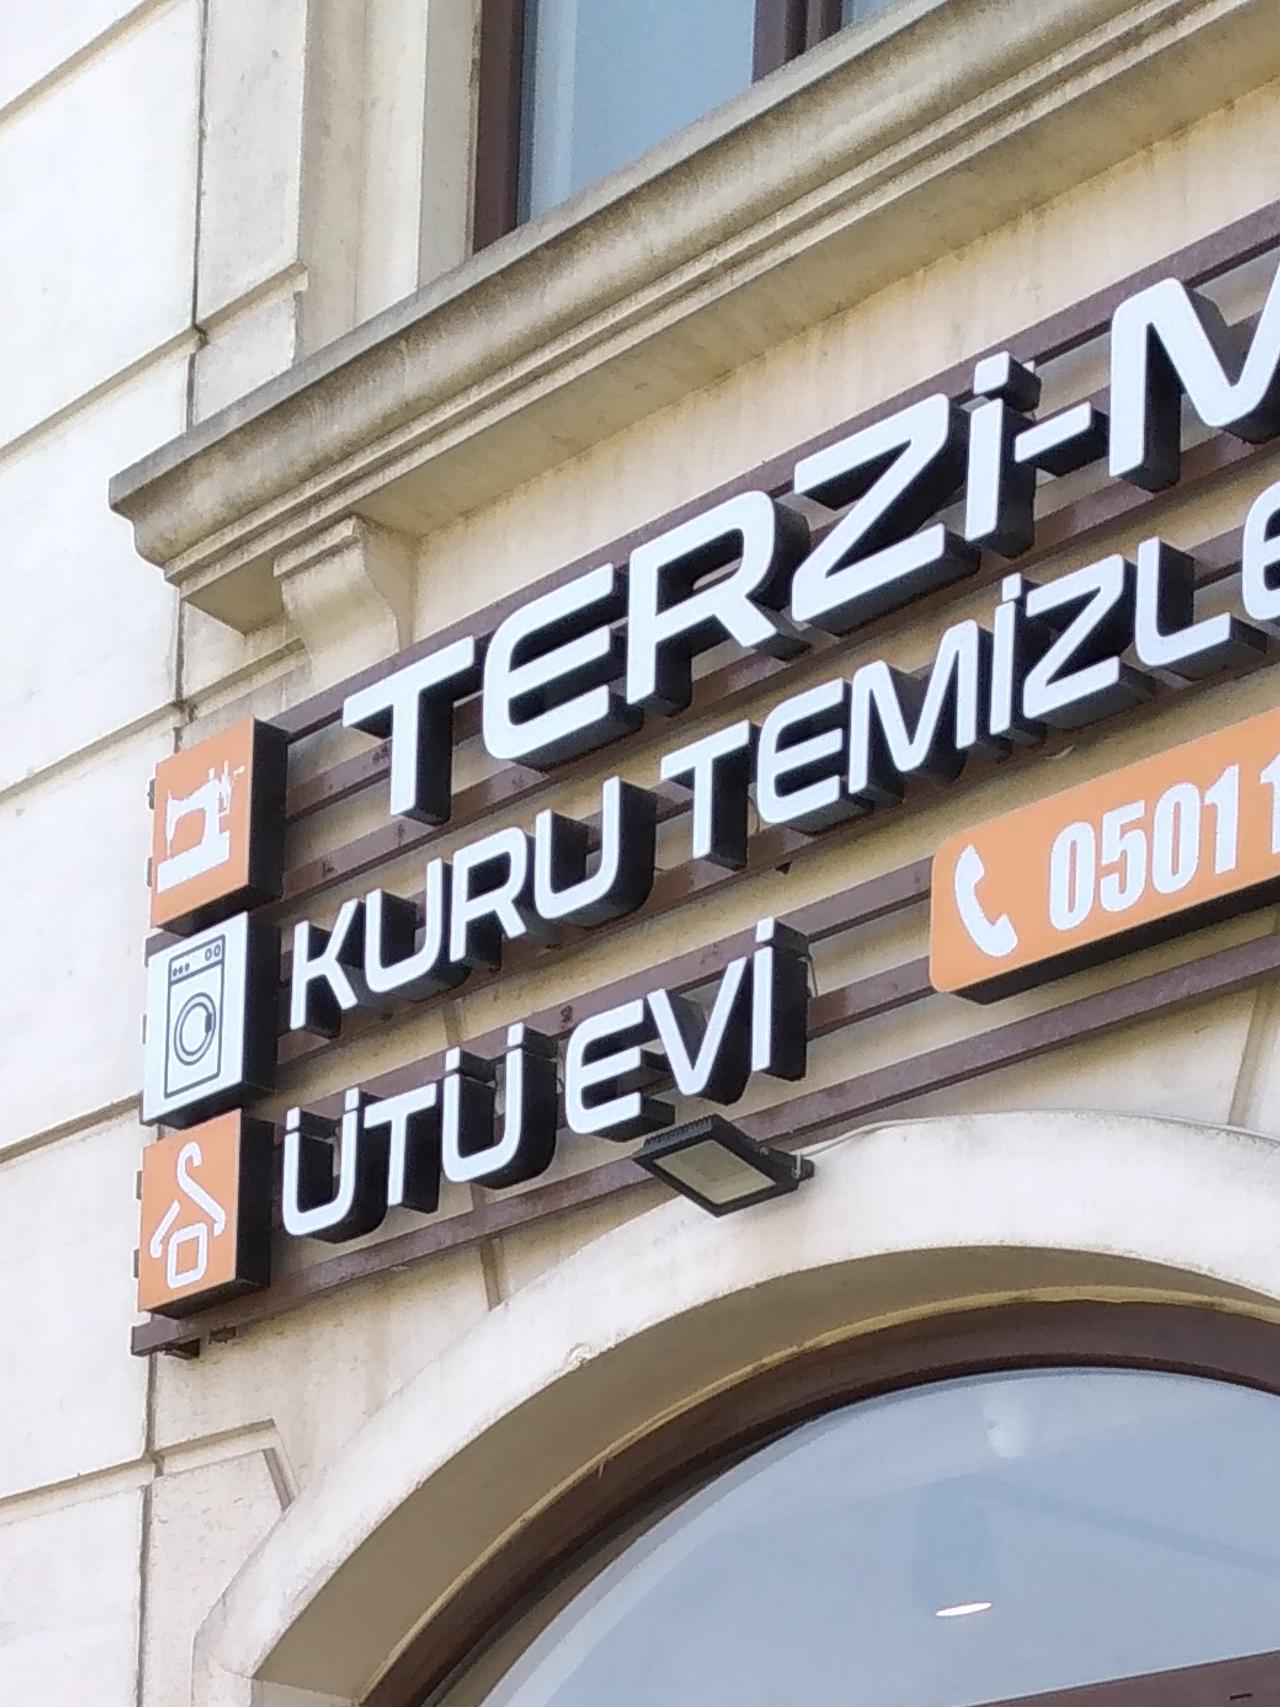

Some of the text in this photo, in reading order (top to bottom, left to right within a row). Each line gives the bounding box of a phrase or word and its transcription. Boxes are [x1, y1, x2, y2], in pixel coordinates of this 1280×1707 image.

[290, 776, 621, 1030] KURU
[1048, 763, 1241, 932] 0501
[281, 915, 776, 1237] ÜTÜ EVİ
